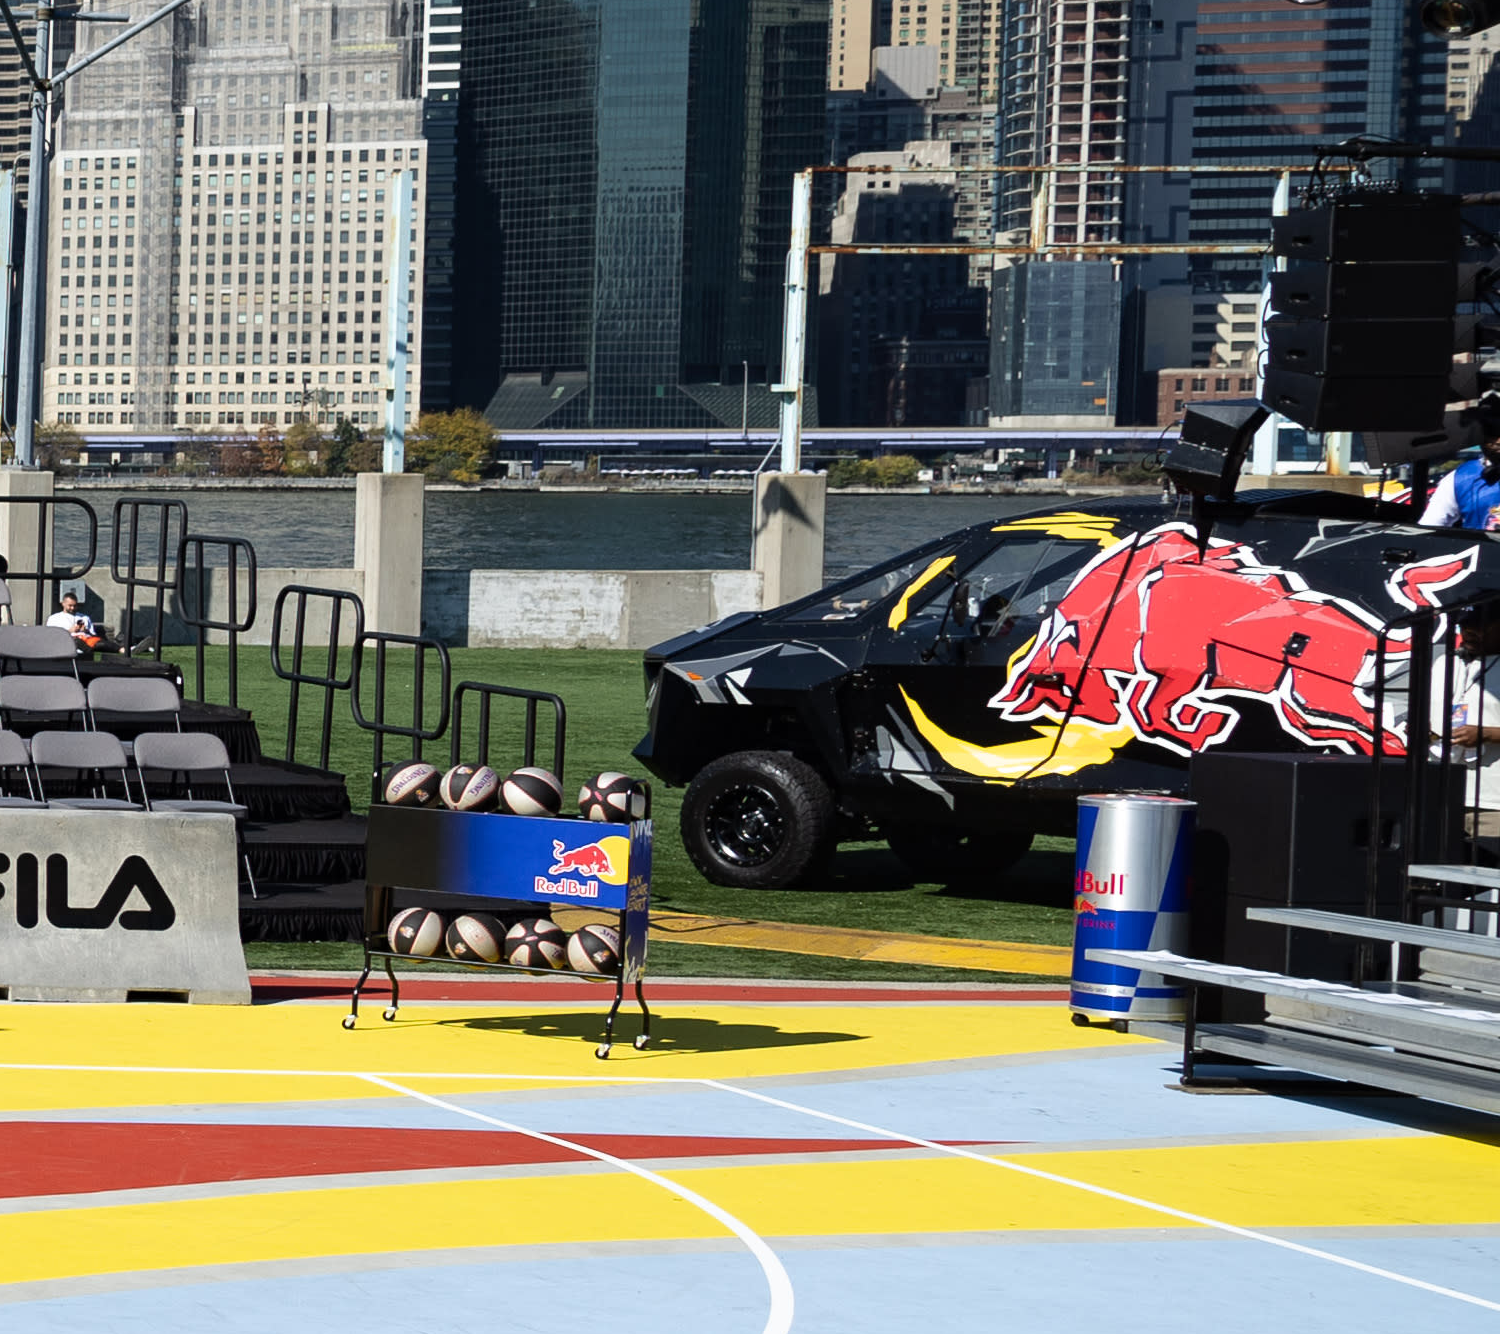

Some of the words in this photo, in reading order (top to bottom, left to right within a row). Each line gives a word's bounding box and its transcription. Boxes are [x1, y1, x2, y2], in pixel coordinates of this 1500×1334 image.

[535, 876, 567, 894] Red
[567, 879, 598, 898] Bull
[1082, 870, 1124, 895] Bull
